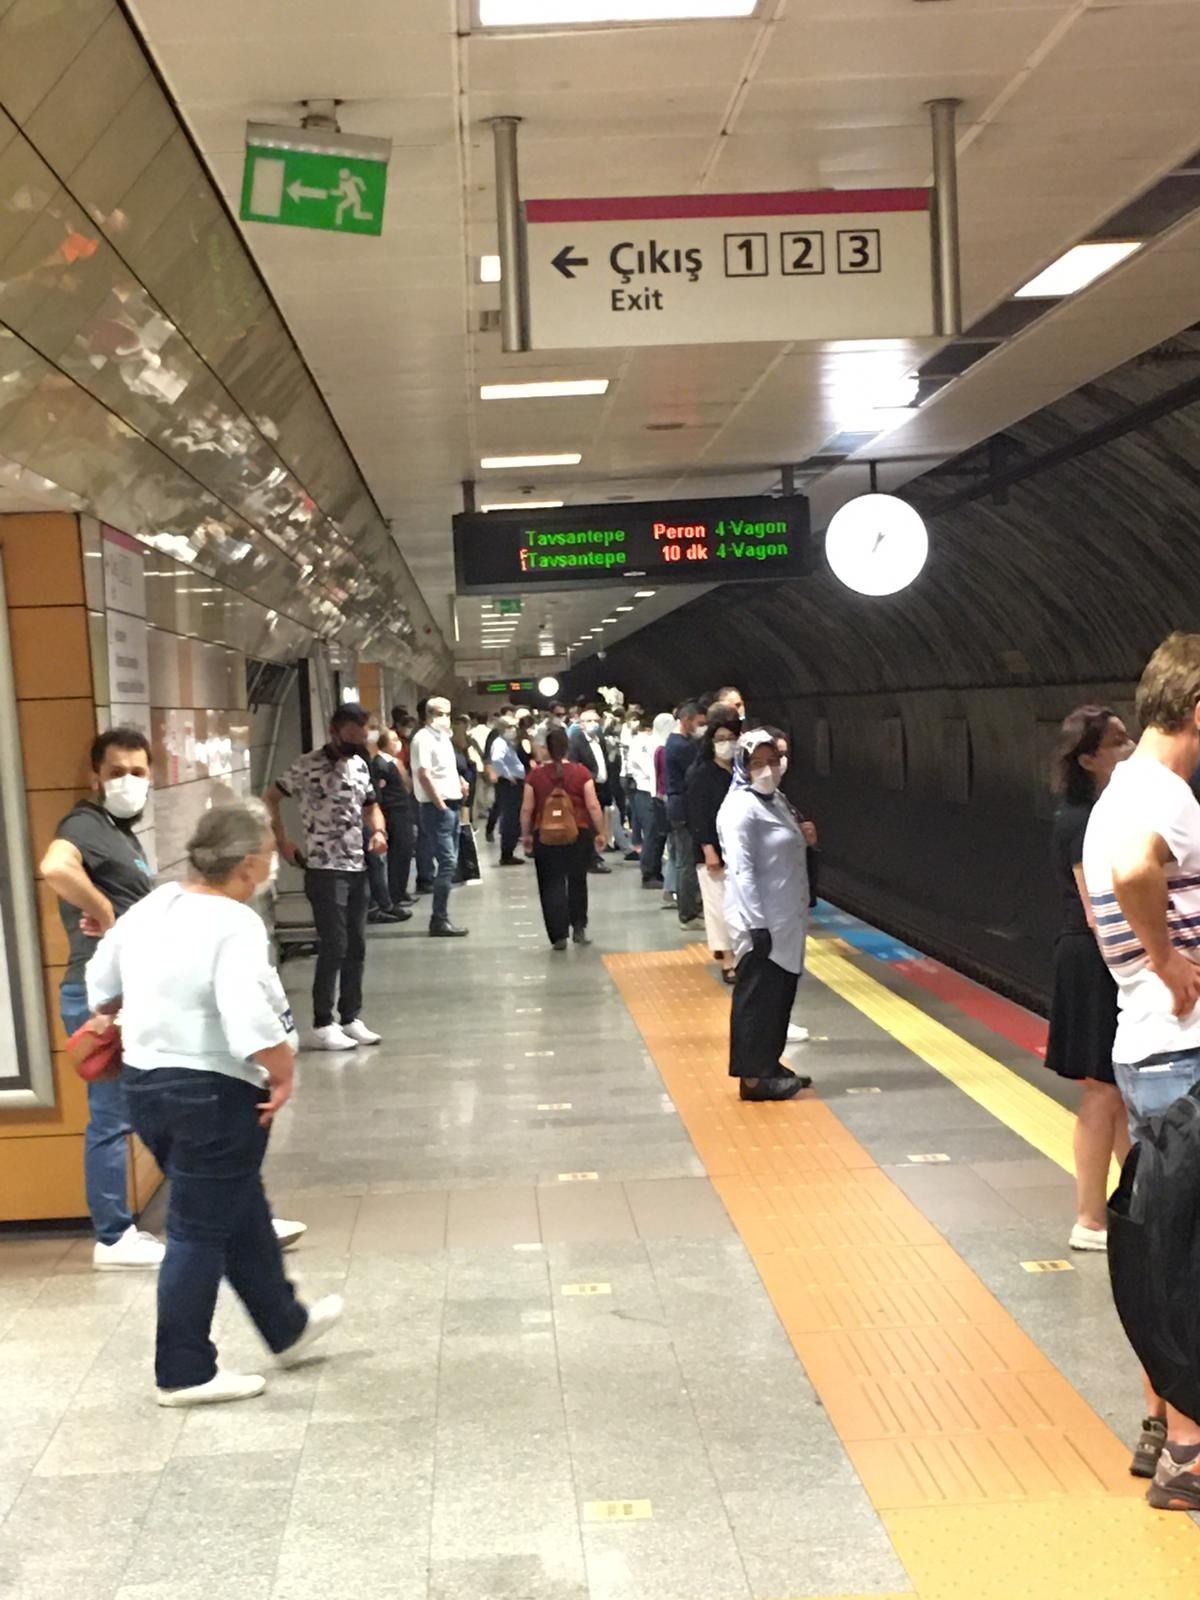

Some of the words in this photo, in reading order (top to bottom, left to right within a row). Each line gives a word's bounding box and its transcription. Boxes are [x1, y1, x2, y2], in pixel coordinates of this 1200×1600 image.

[610, 240, 703, 284] Çıkış
[792, 237, 814, 270] 2
[849, 235, 870, 268] 3
[611, 287, 664, 311] Exit
[653, 523, 706, 540] Peron
[662, 545, 681, 562] 10
[686, 543, 708, 560] dk
